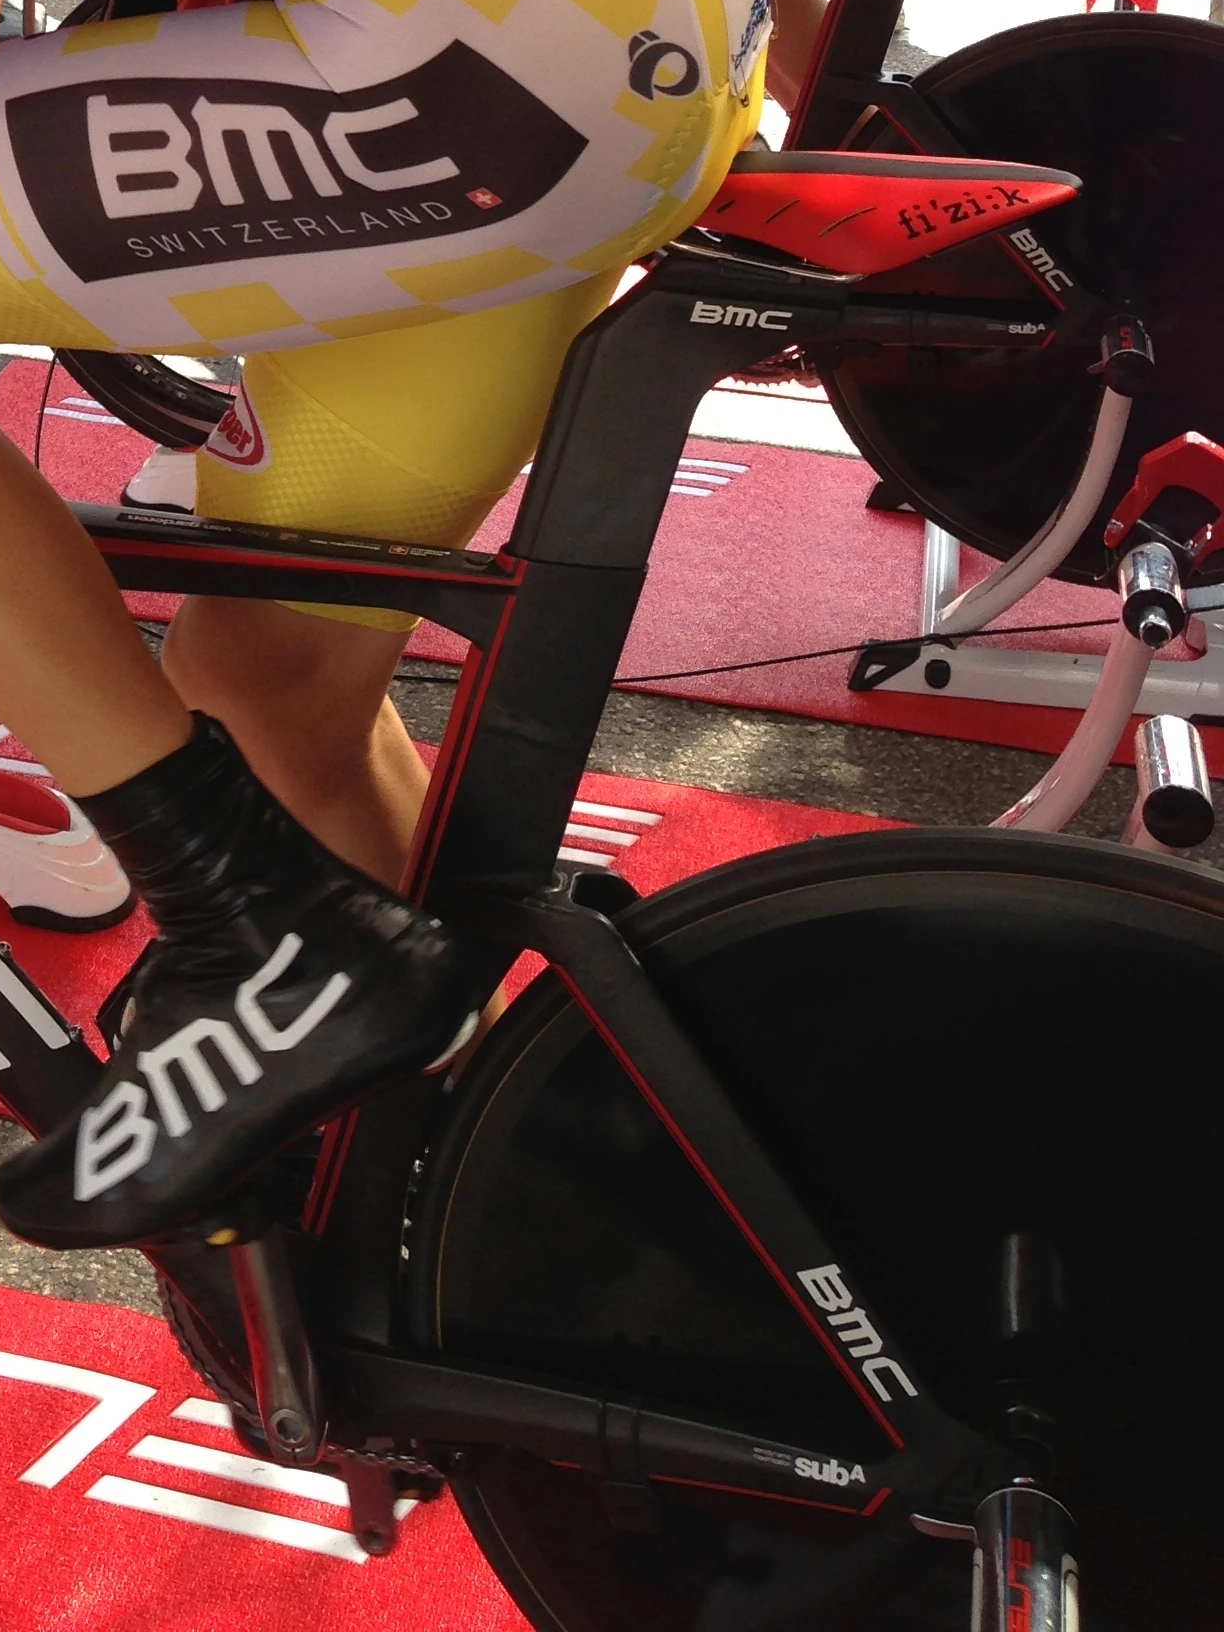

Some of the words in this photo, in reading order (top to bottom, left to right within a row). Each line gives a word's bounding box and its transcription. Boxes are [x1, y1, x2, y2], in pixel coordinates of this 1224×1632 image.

[87, 94, 461, 220] BMC
[126, 200, 454, 260] SWITZERLAND
[1010, 227, 1074, 293] BMC
[689, 300, 794, 331] BMC
[74, 932, 353, 1203] BMC
[796, 1263, 919, 1403] BMC
